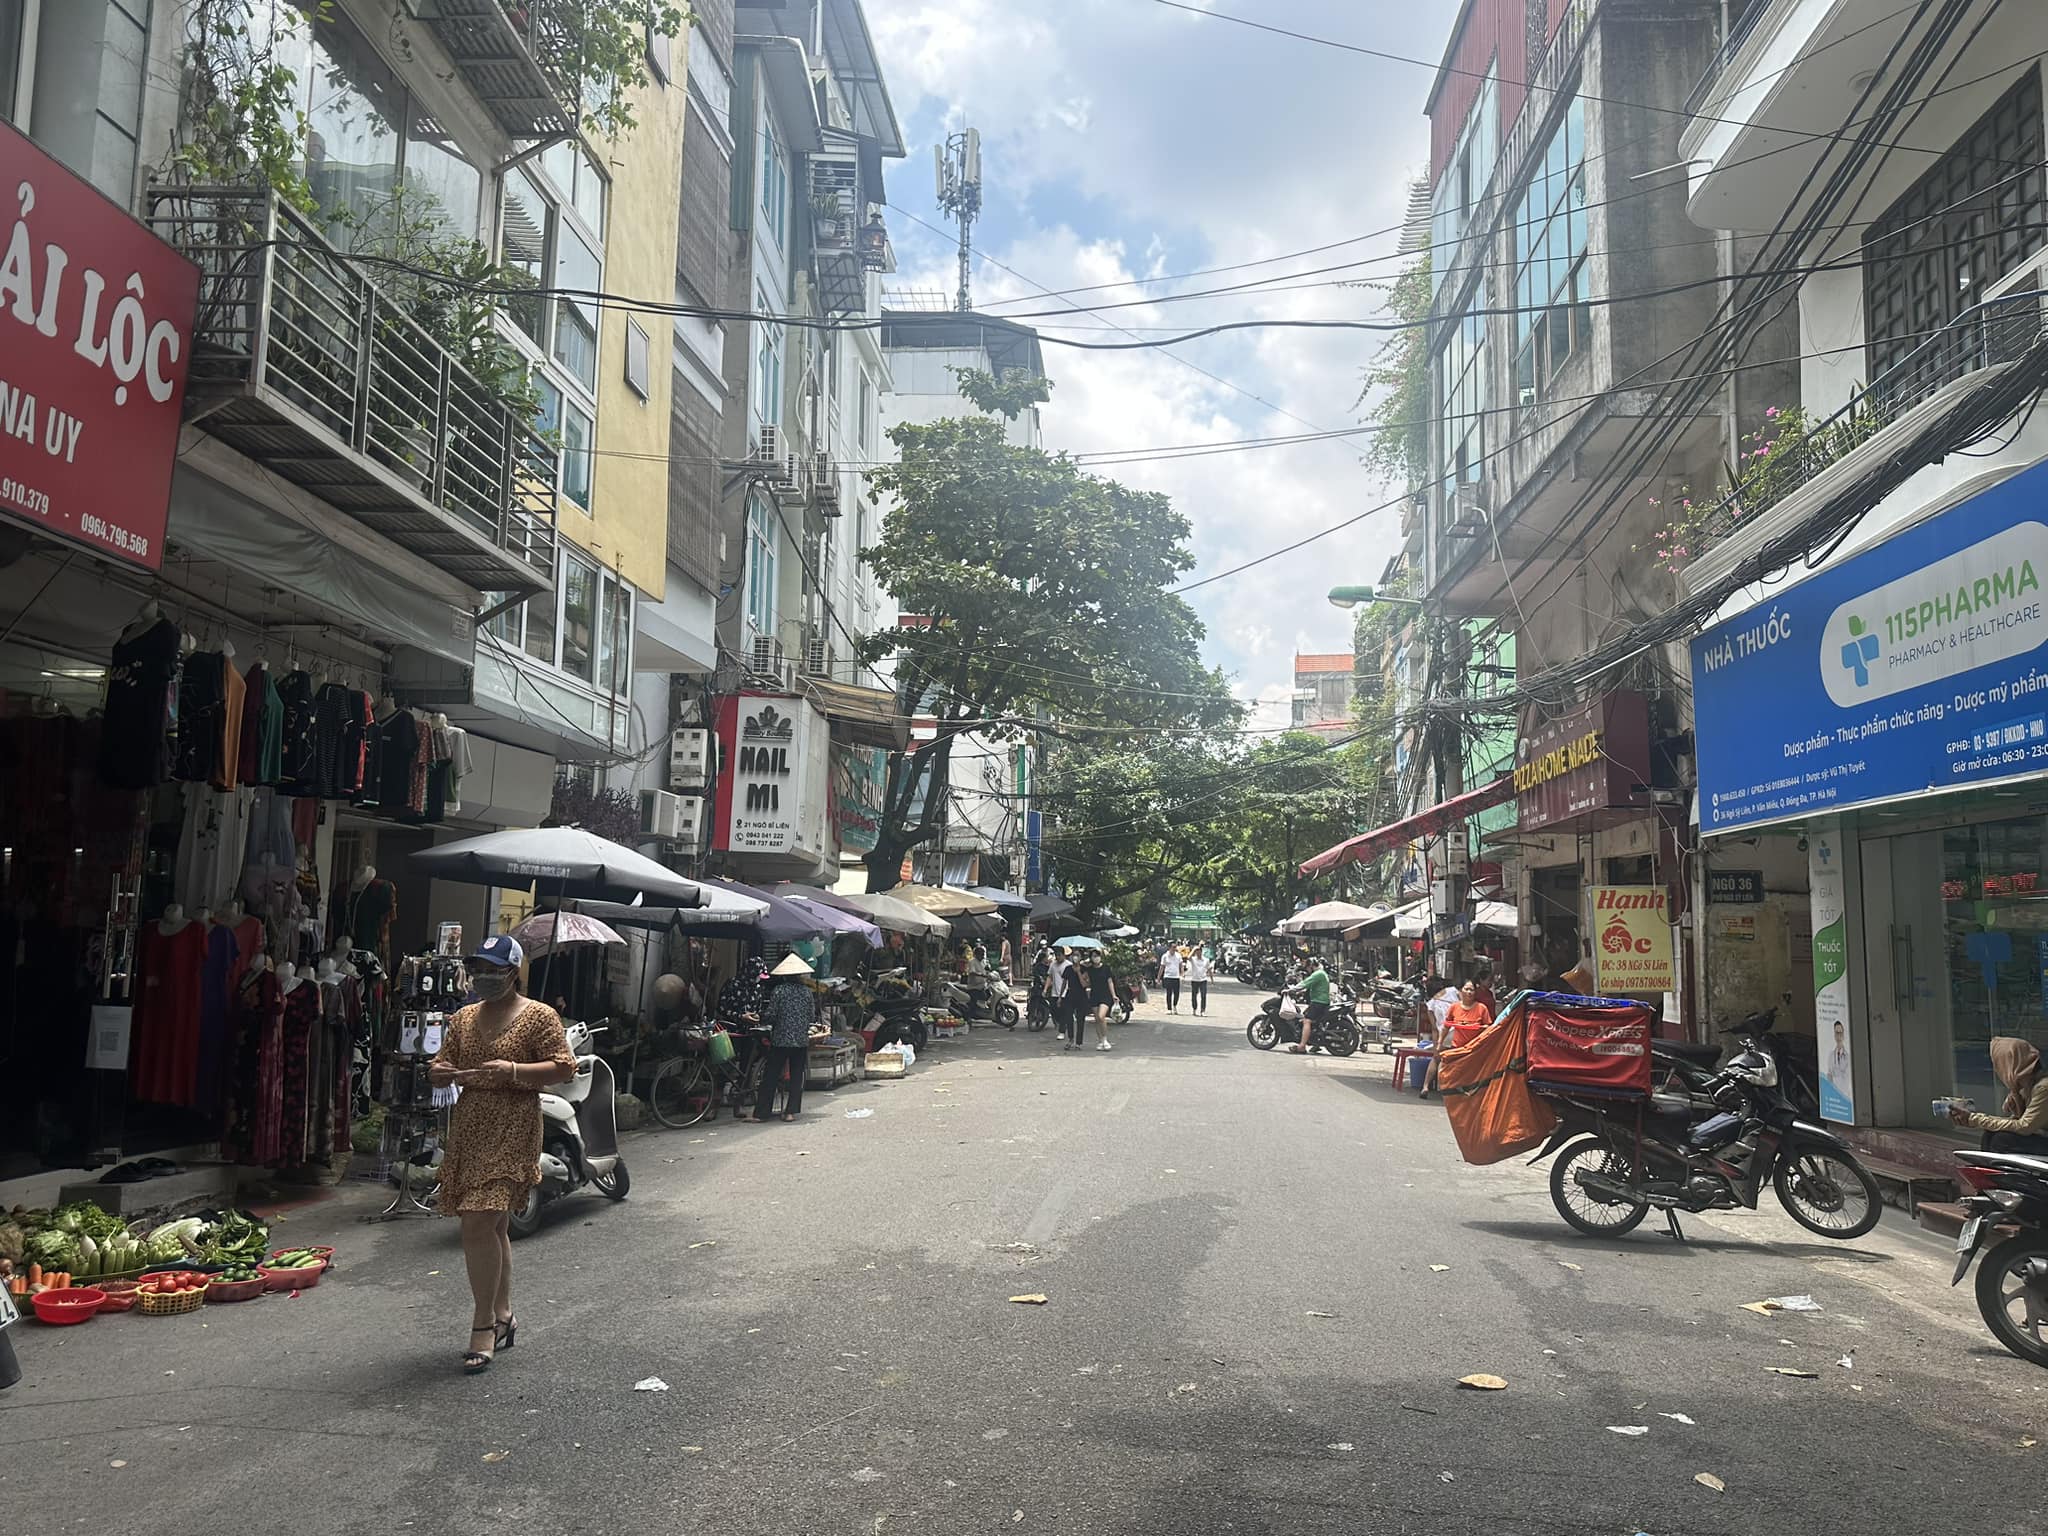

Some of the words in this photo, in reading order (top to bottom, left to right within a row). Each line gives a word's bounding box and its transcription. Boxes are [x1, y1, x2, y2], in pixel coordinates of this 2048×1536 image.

[74, 271, 180, 406] LỘC
[45, 406, 84, 464] UY
[81, 512, 149, 557] 0964.796.568
[1885, 559, 2039, 645] 115PHARMA
[1704, 635, 1734, 673] NHÀ
[1736, 605, 1792, 659] THUỐC
[1888, 637, 1946, 669] PHARMACY
[1949, 633, 1957, 648] &
[1959, 602, 2041, 645] HEALTHCARE
[1783, 741, 1805, 758] Dược
[1806, 730, 1829, 754] phẩm
[1836, 726, 1859, 745] Thực
[1861, 713, 1888, 740] phẩm
[1890, 709, 1914, 729] chức
[1916, 703, 1944, 722] năng
[1954, 691, 1986, 712] Dược
[1988, 681, 2008, 703] mỹ
[740, 746, 790, 773] NAIL
[1513, 767, 1538, 794] PIZZA
[1538, 745, 1567, 784] HOME
[1952, 760, 1966, 773] Giờ
[1968, 756, 1981, 770] mở
[1982, 754, 2001, 768] cửa:
[2002, 748, 2025, 763] 06:30
[747, 783, 779, 810] MI
[1596, 889, 1665, 915] Hạnh
[1738, 878, 1753, 891] 36
[1817, 938, 1842, 953] THUỐC
